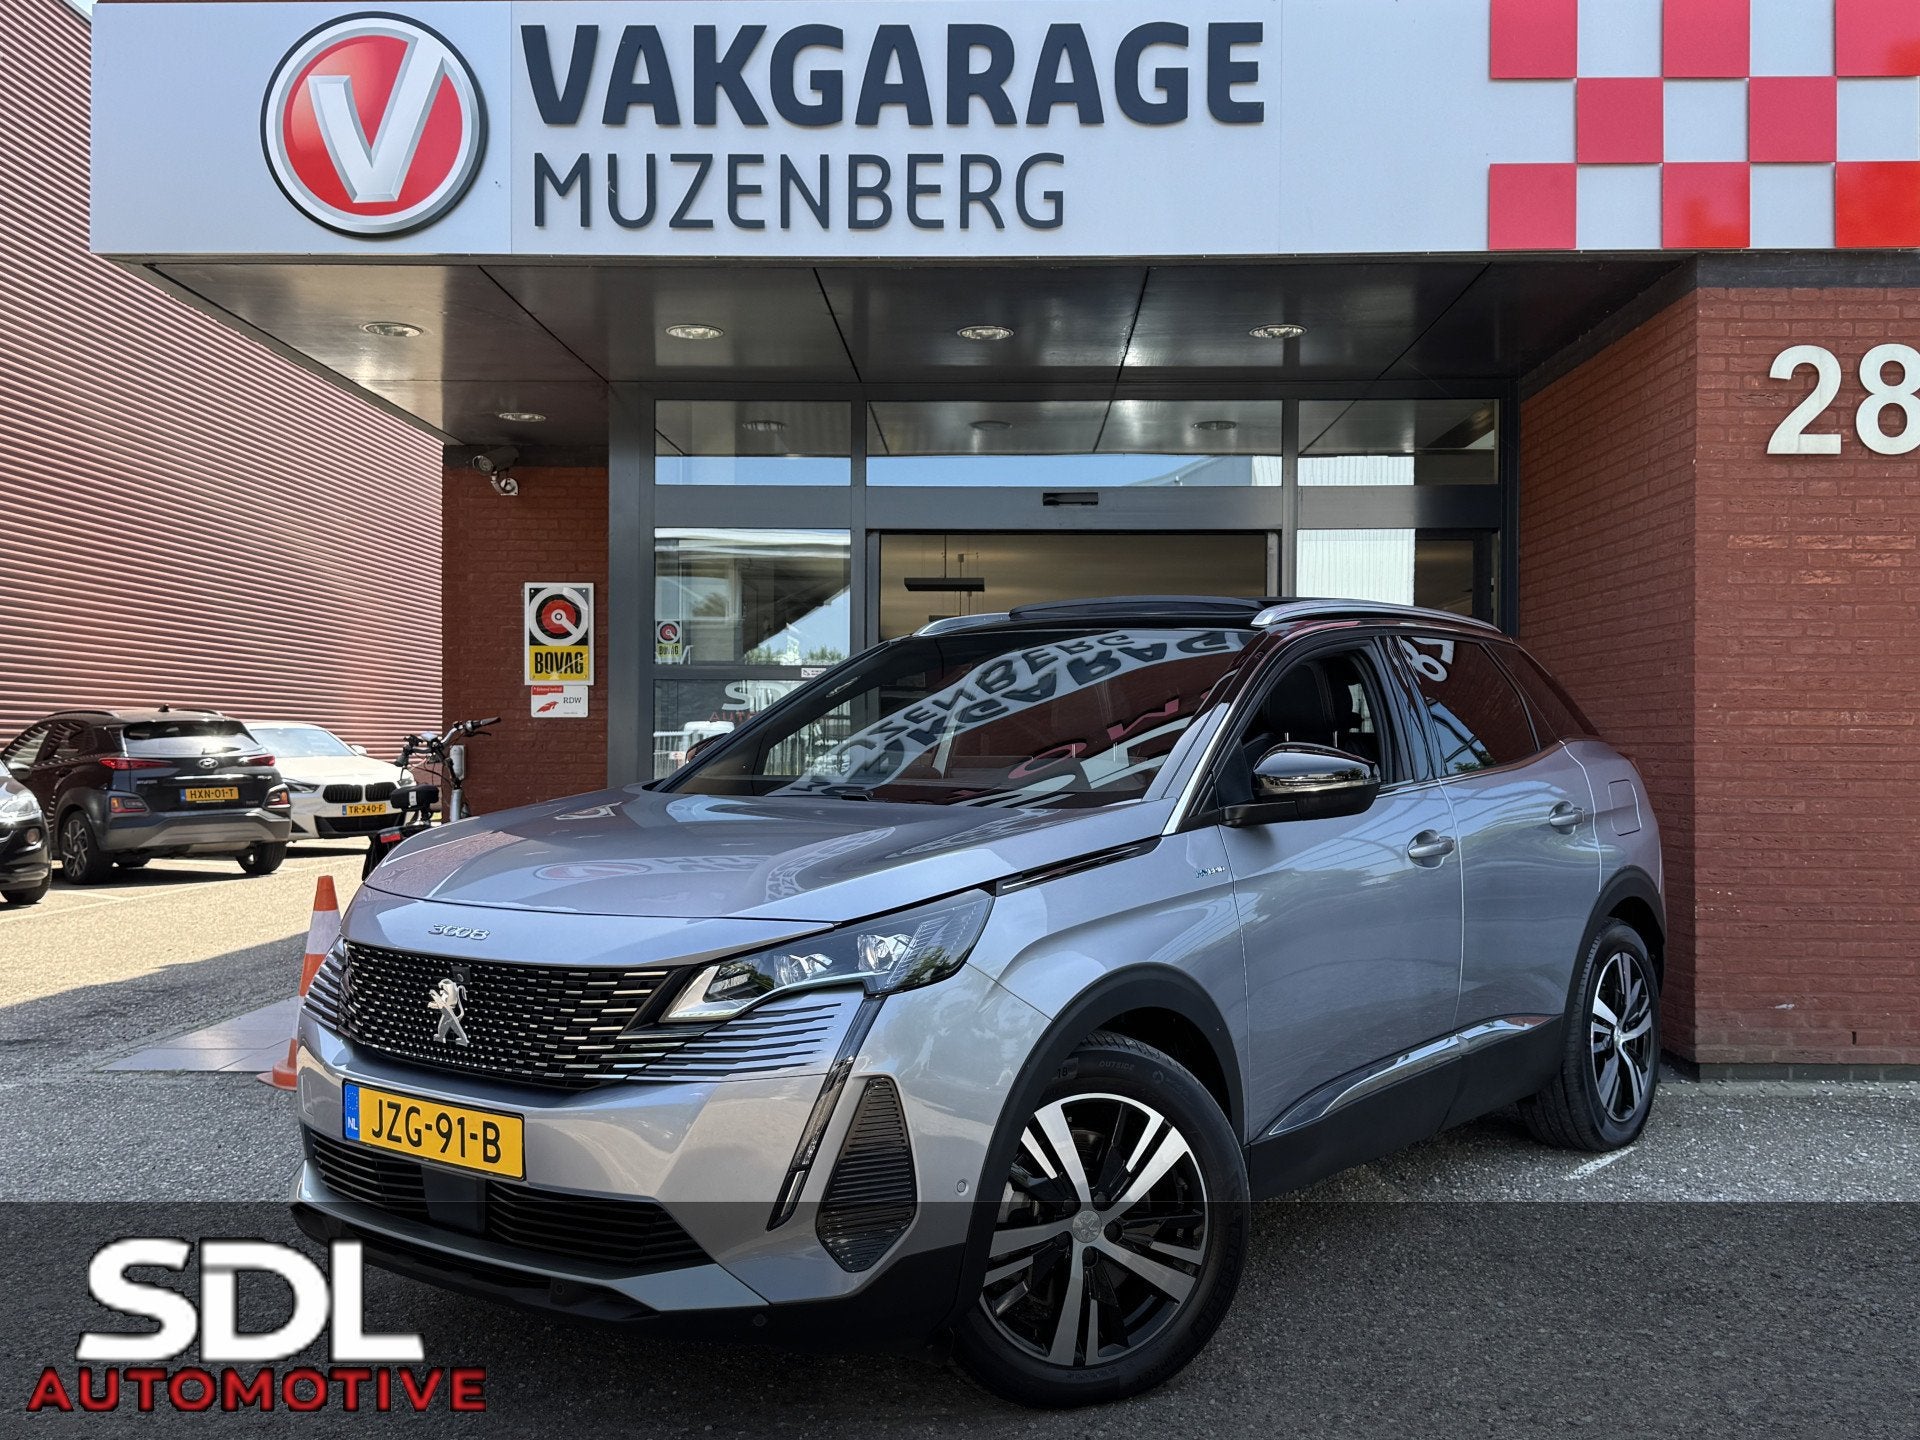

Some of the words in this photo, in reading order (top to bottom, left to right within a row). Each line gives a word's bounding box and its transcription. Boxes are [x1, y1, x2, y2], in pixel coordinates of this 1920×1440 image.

[520, 21, 1265, 129] VAKGARAGE
[307, 36, 446, 204] V
[532, 152, 1066, 230] MUZENBERG
[1766, 343, 1920, 456] 28
[533, 650, 585, 675] BOVAG
[562, 696, 582, 704] RDW
[189, 788, 235, 801] HXN-01-T
[428, 924, 490, 940] 3008
[347, 1116, 359, 1131] NL
[371, 1098, 502, 1164] JZG-91-B
